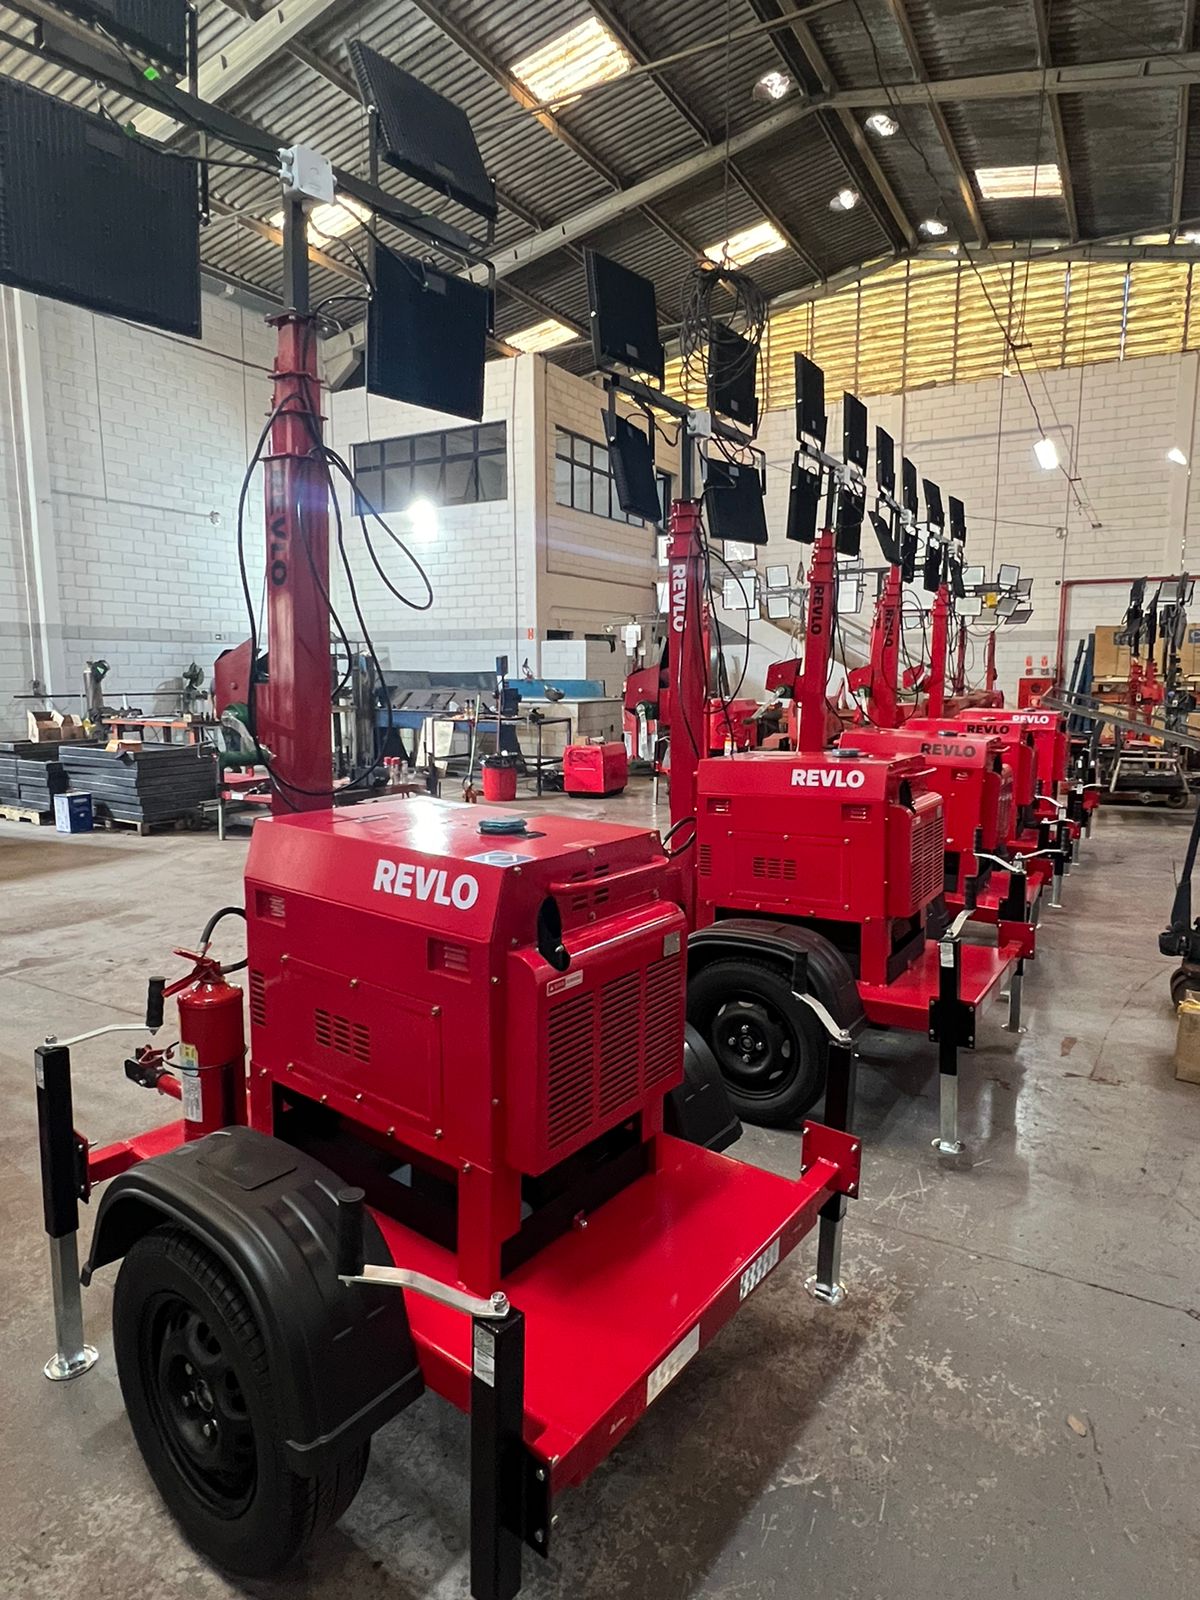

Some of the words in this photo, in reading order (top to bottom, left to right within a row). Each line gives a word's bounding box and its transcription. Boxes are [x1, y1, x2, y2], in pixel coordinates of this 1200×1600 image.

[672, 564, 688, 633] REVLO
[811, 585, 825, 635] REVLO
[966, 724, 1010, 735] REVLO
[1012, 714, 1049, 725] REVLO
[921, 742, 977, 758] REVLO
[791, 768, 865, 789] REVLO
[373, 858, 479, 911] REVLO
